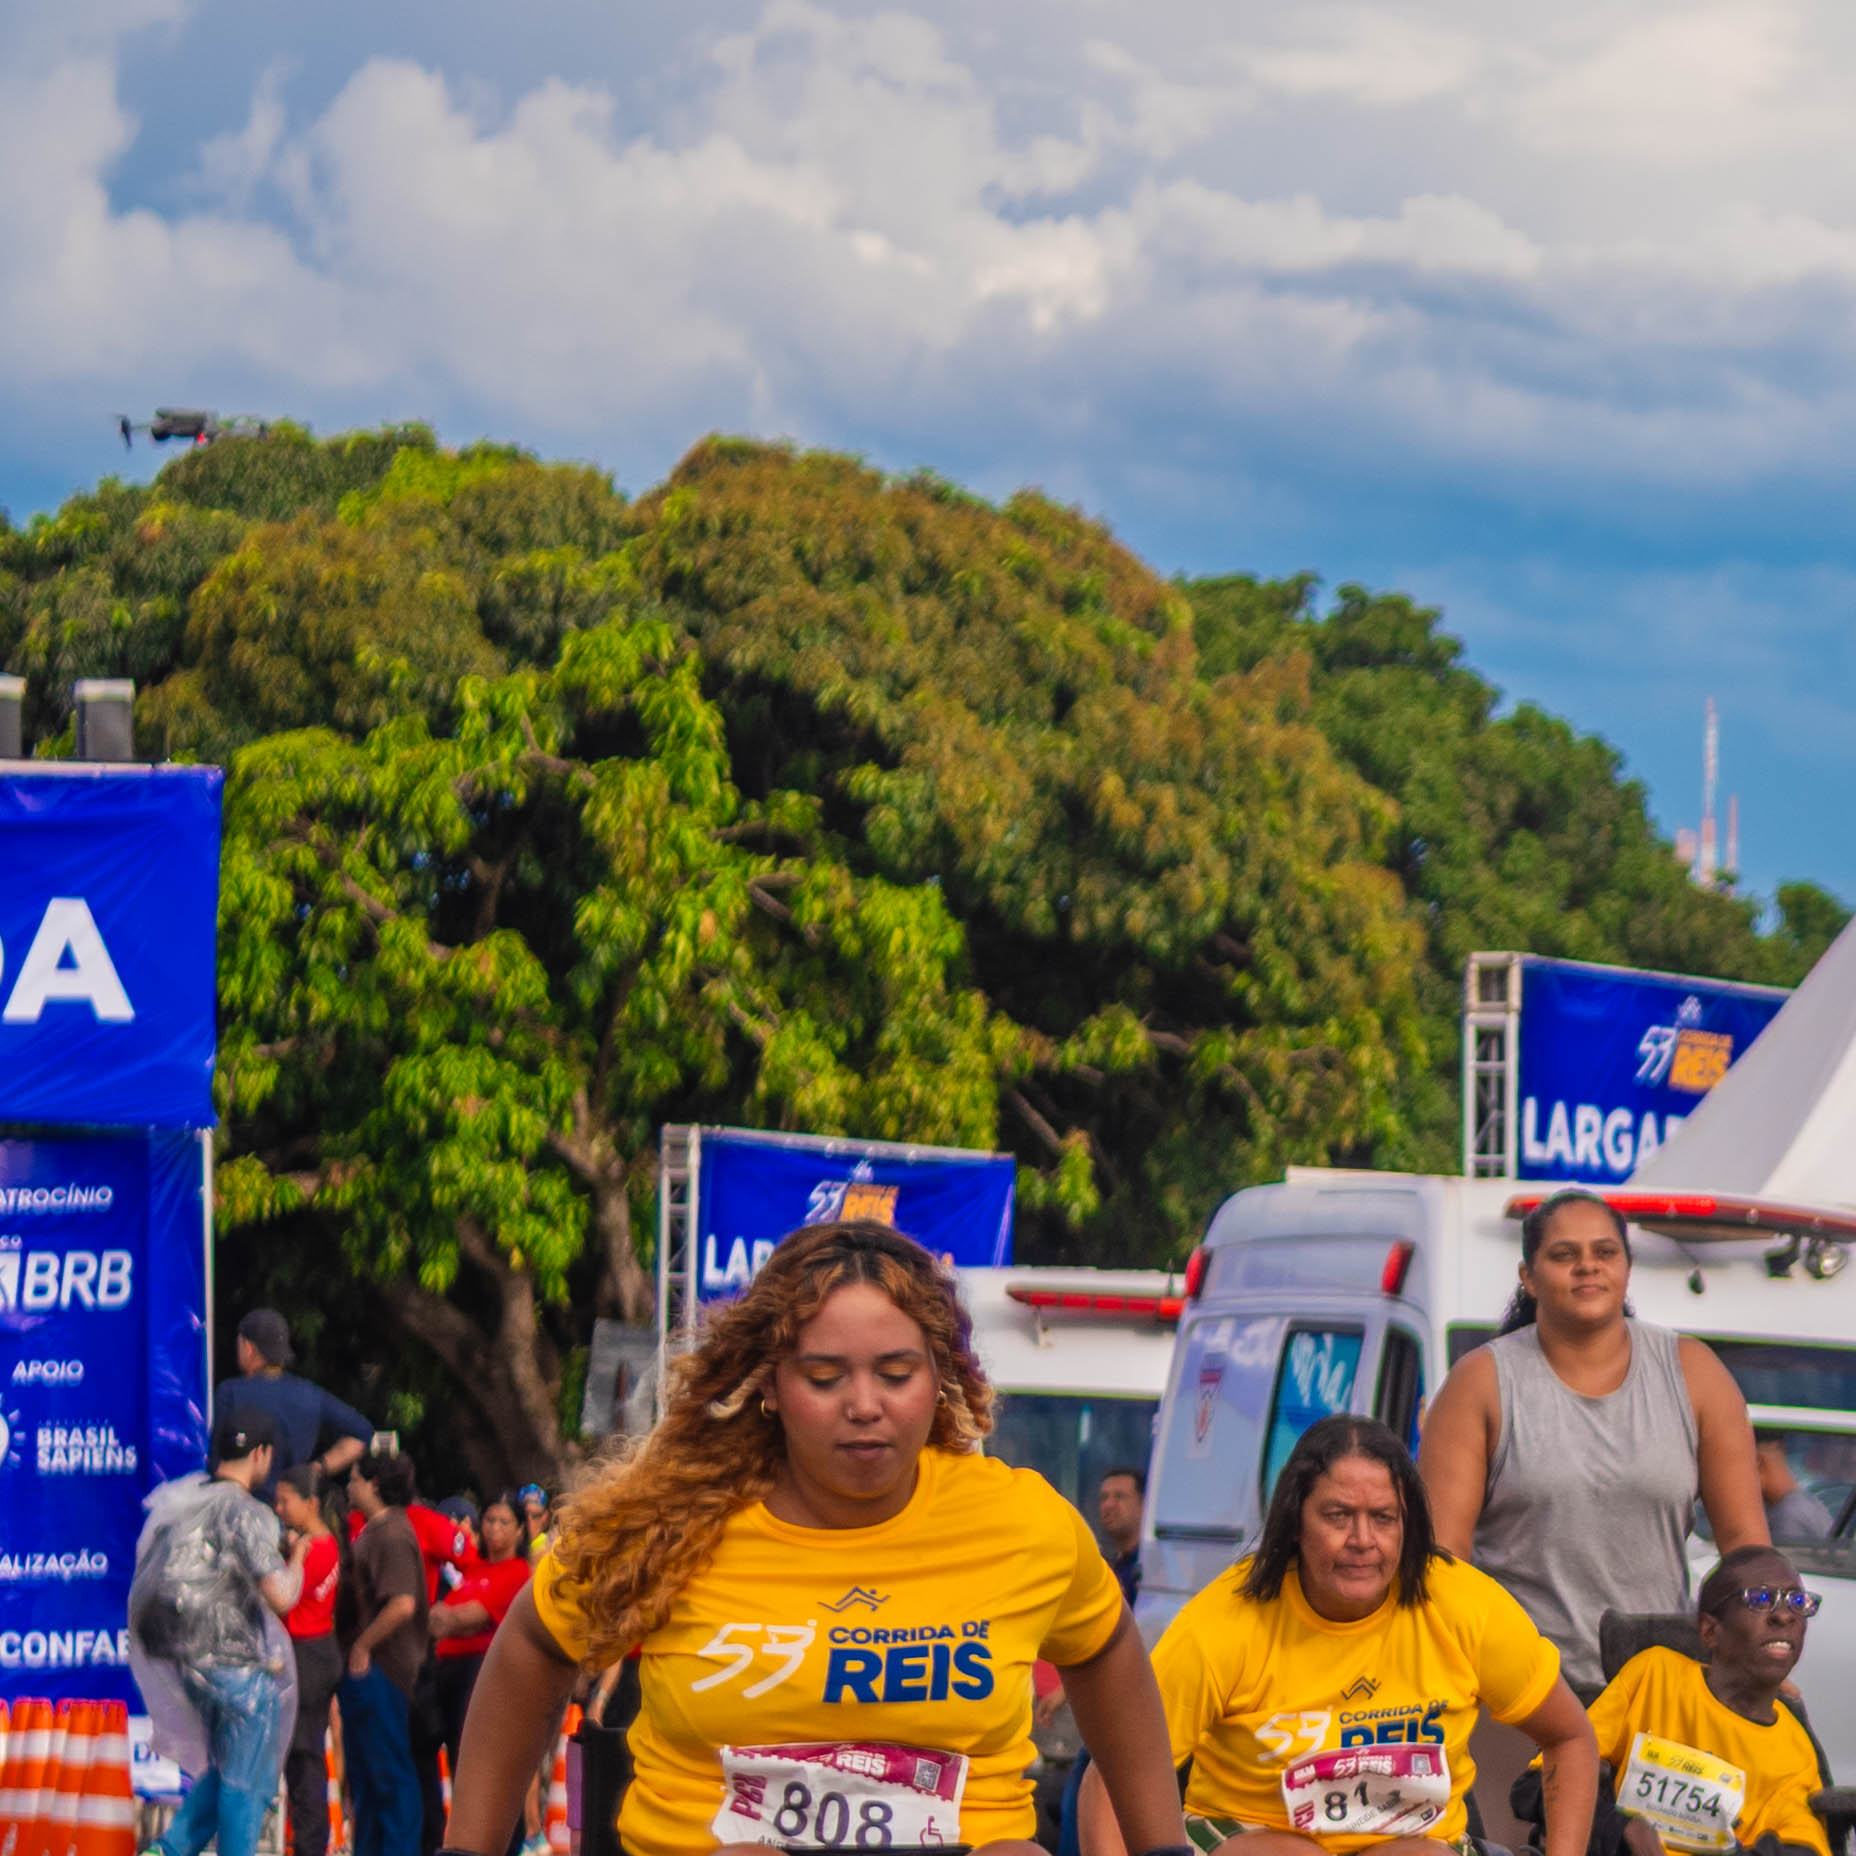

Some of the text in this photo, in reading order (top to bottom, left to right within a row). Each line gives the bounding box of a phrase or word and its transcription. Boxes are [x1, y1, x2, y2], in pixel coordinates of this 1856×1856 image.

[22, 1249, 133, 1312] BRB
[12, 1359, 84, 1386] APOIO
[36, 1426, 120, 1449] BRASIL
[36, 1445, 138, 1475] SAPIENS
[828, 1619, 991, 1645] CORRIDA DE
[821, 1640, 995, 1705] REIS
[1338, 1703, 1423, 1725] CORRIDA
[836, 1751, 887, 1780] REIS
[1635, 1770, 1722, 1818] 51754
[773, 1780, 894, 1850] 808
